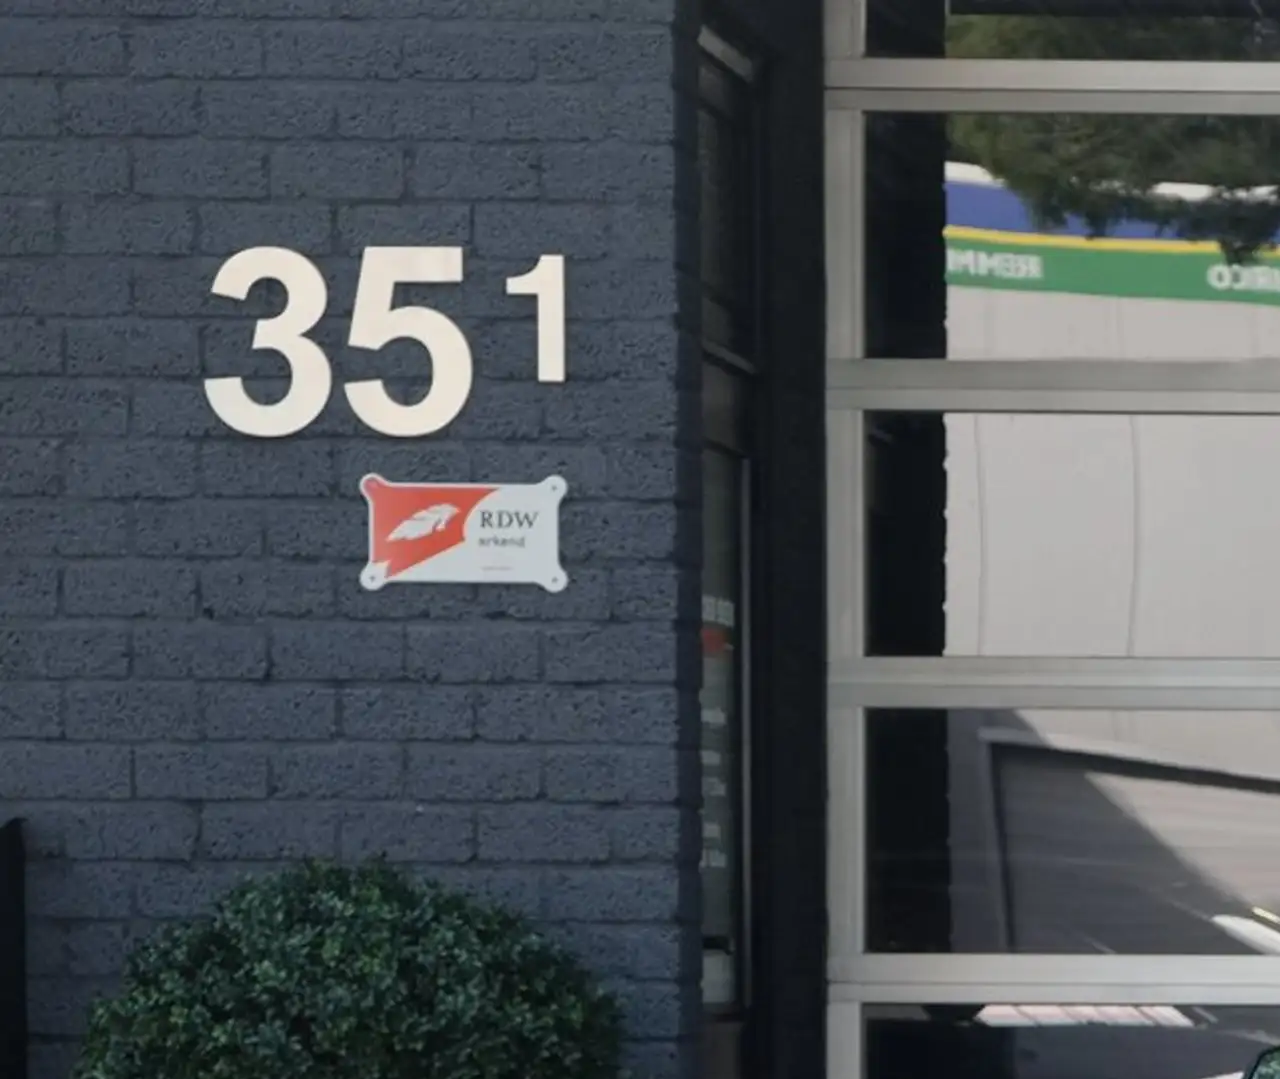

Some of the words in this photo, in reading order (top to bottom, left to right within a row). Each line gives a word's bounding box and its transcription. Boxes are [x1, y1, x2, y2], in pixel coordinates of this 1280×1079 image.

[203, 246, 473, 437] 35
[506, 254, 565, 383] 1
[480, 510, 539, 529] RDW
